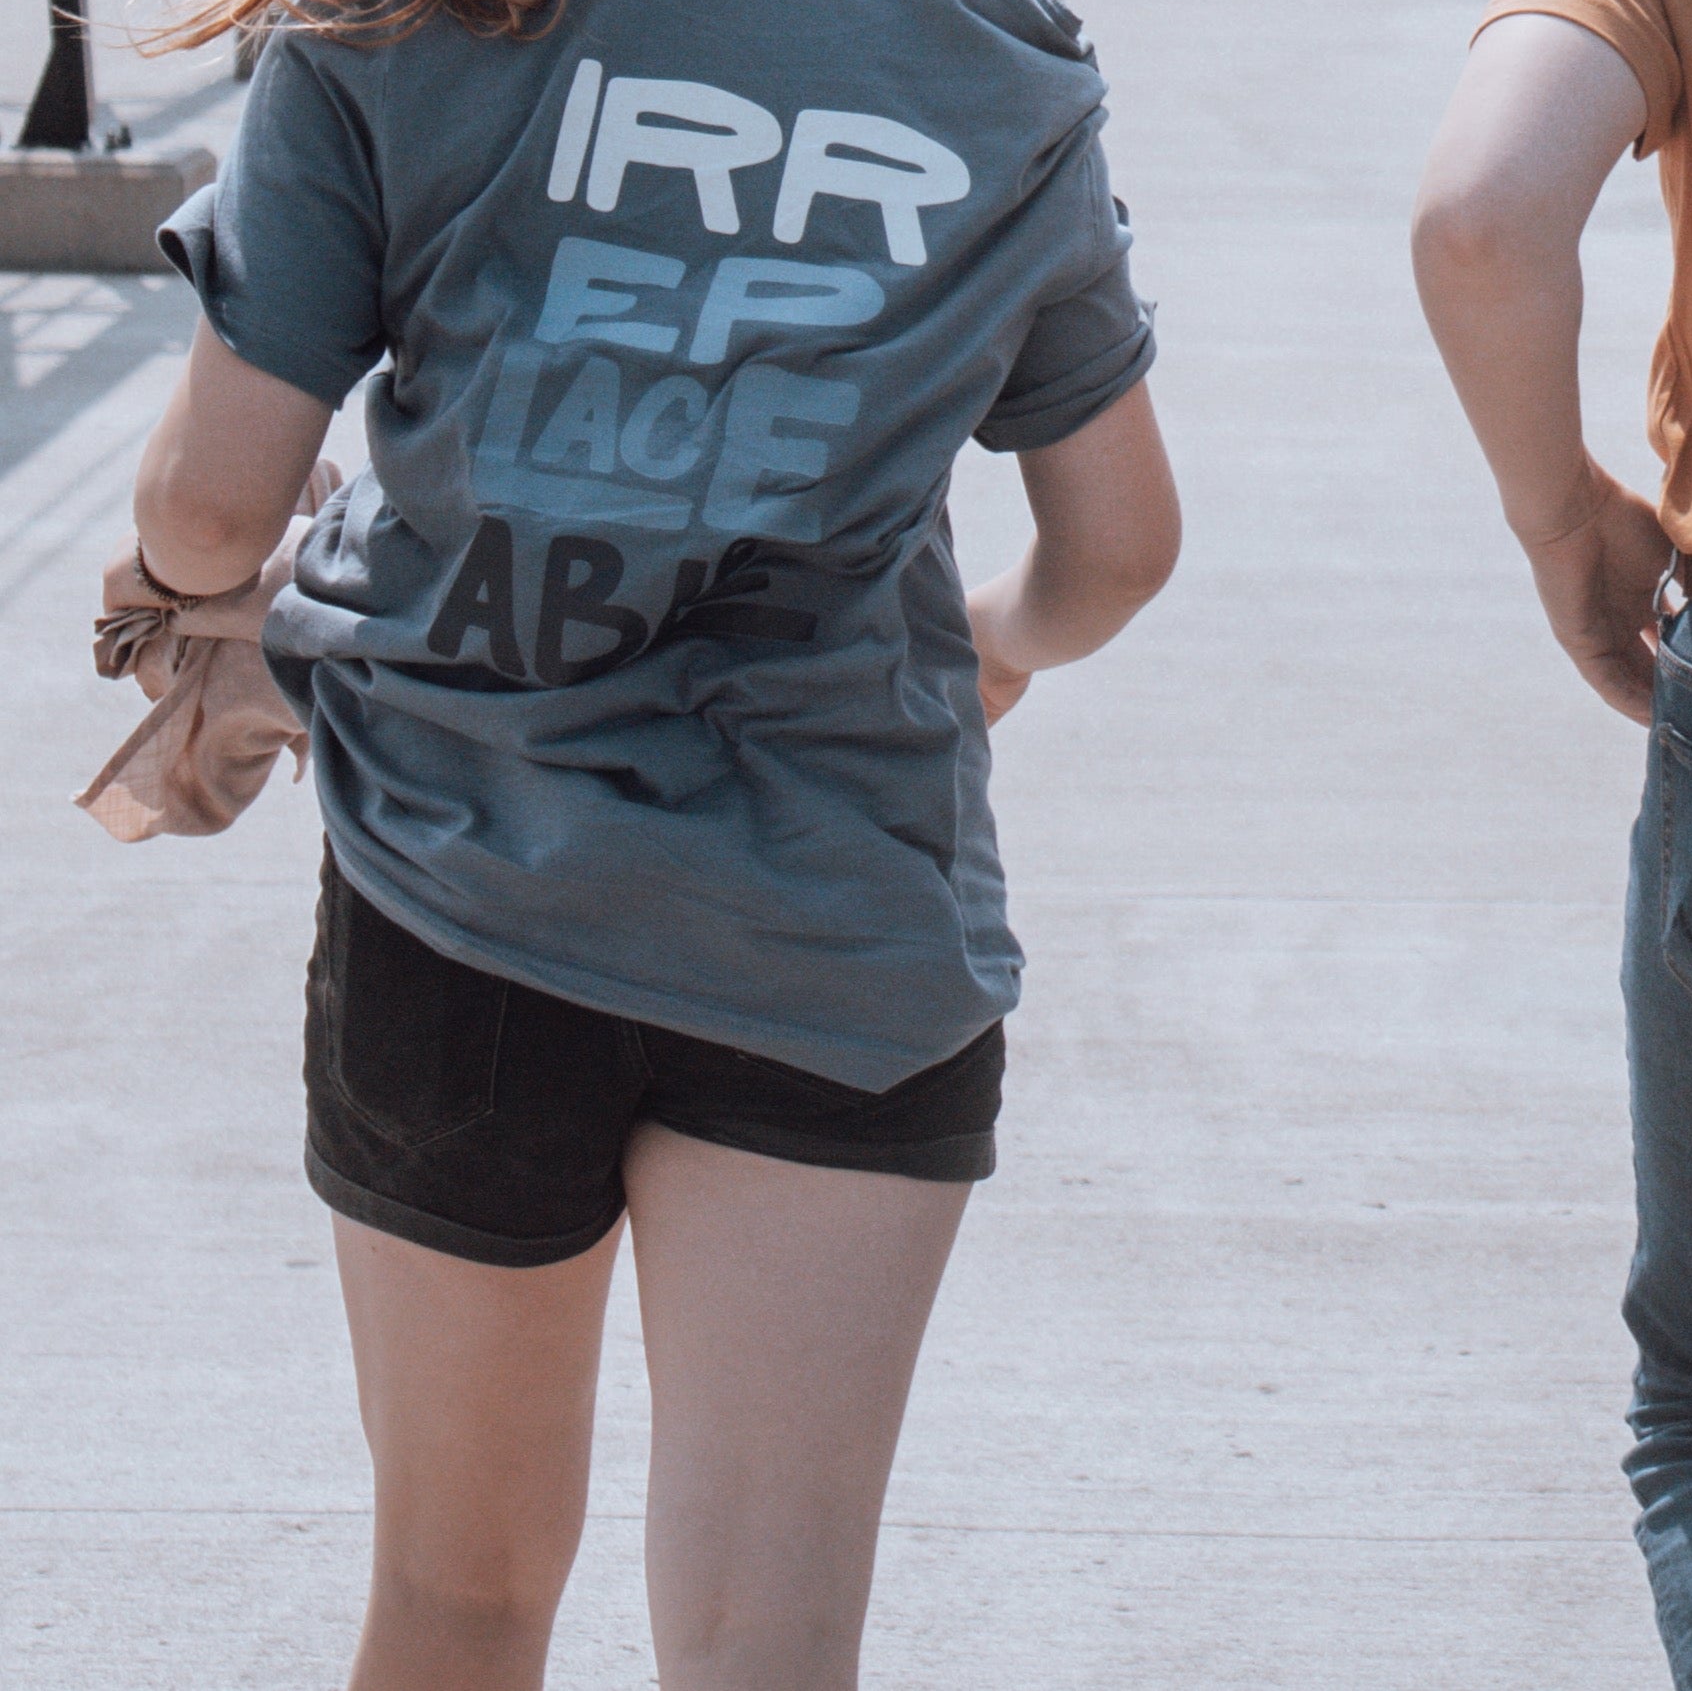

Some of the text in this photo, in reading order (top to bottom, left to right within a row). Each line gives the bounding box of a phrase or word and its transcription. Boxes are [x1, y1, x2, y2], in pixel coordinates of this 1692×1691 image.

[547, 58, 971, 266] IRR
[533, 236, 886, 365] EP
[471, 341, 862, 543] LACE
